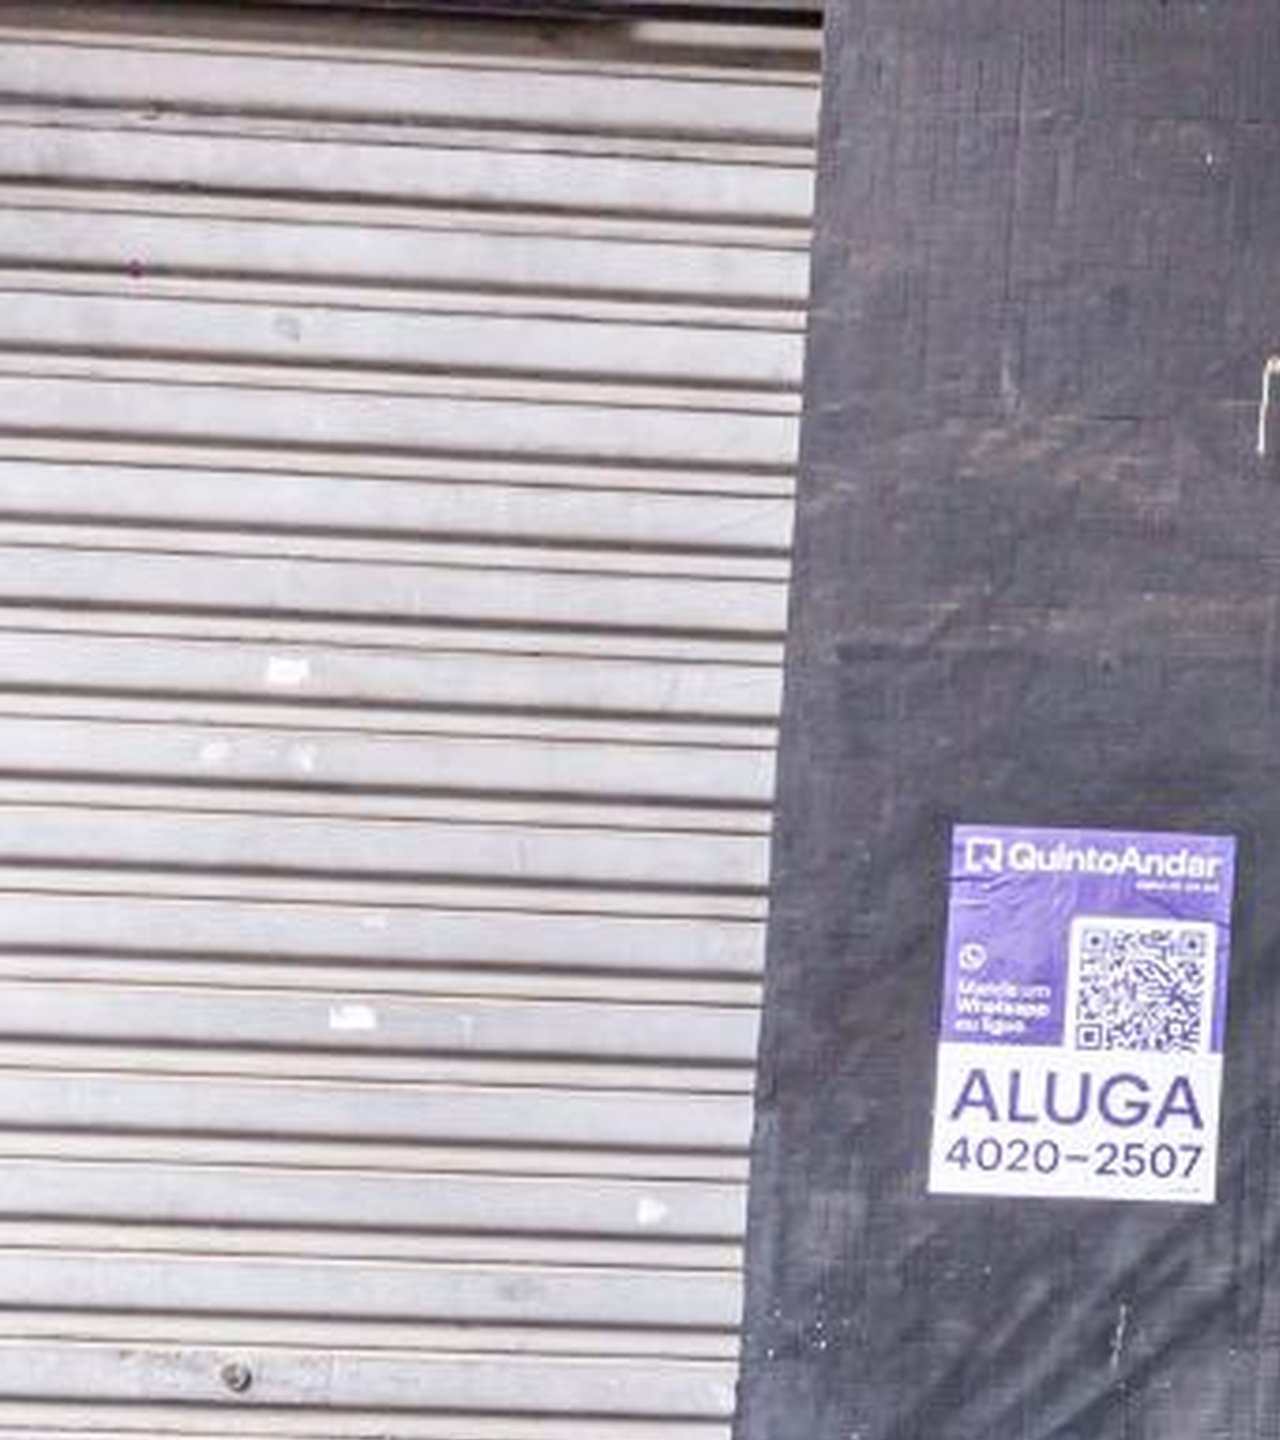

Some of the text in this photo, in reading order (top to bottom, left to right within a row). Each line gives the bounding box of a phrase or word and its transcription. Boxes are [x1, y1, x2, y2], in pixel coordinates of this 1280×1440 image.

[1009, 840, 1223, 878] QuintoAndar
[950, 1068, 1204, 1130] ALUGA
[945, 1135, 1203, 1179] 4020-2507
